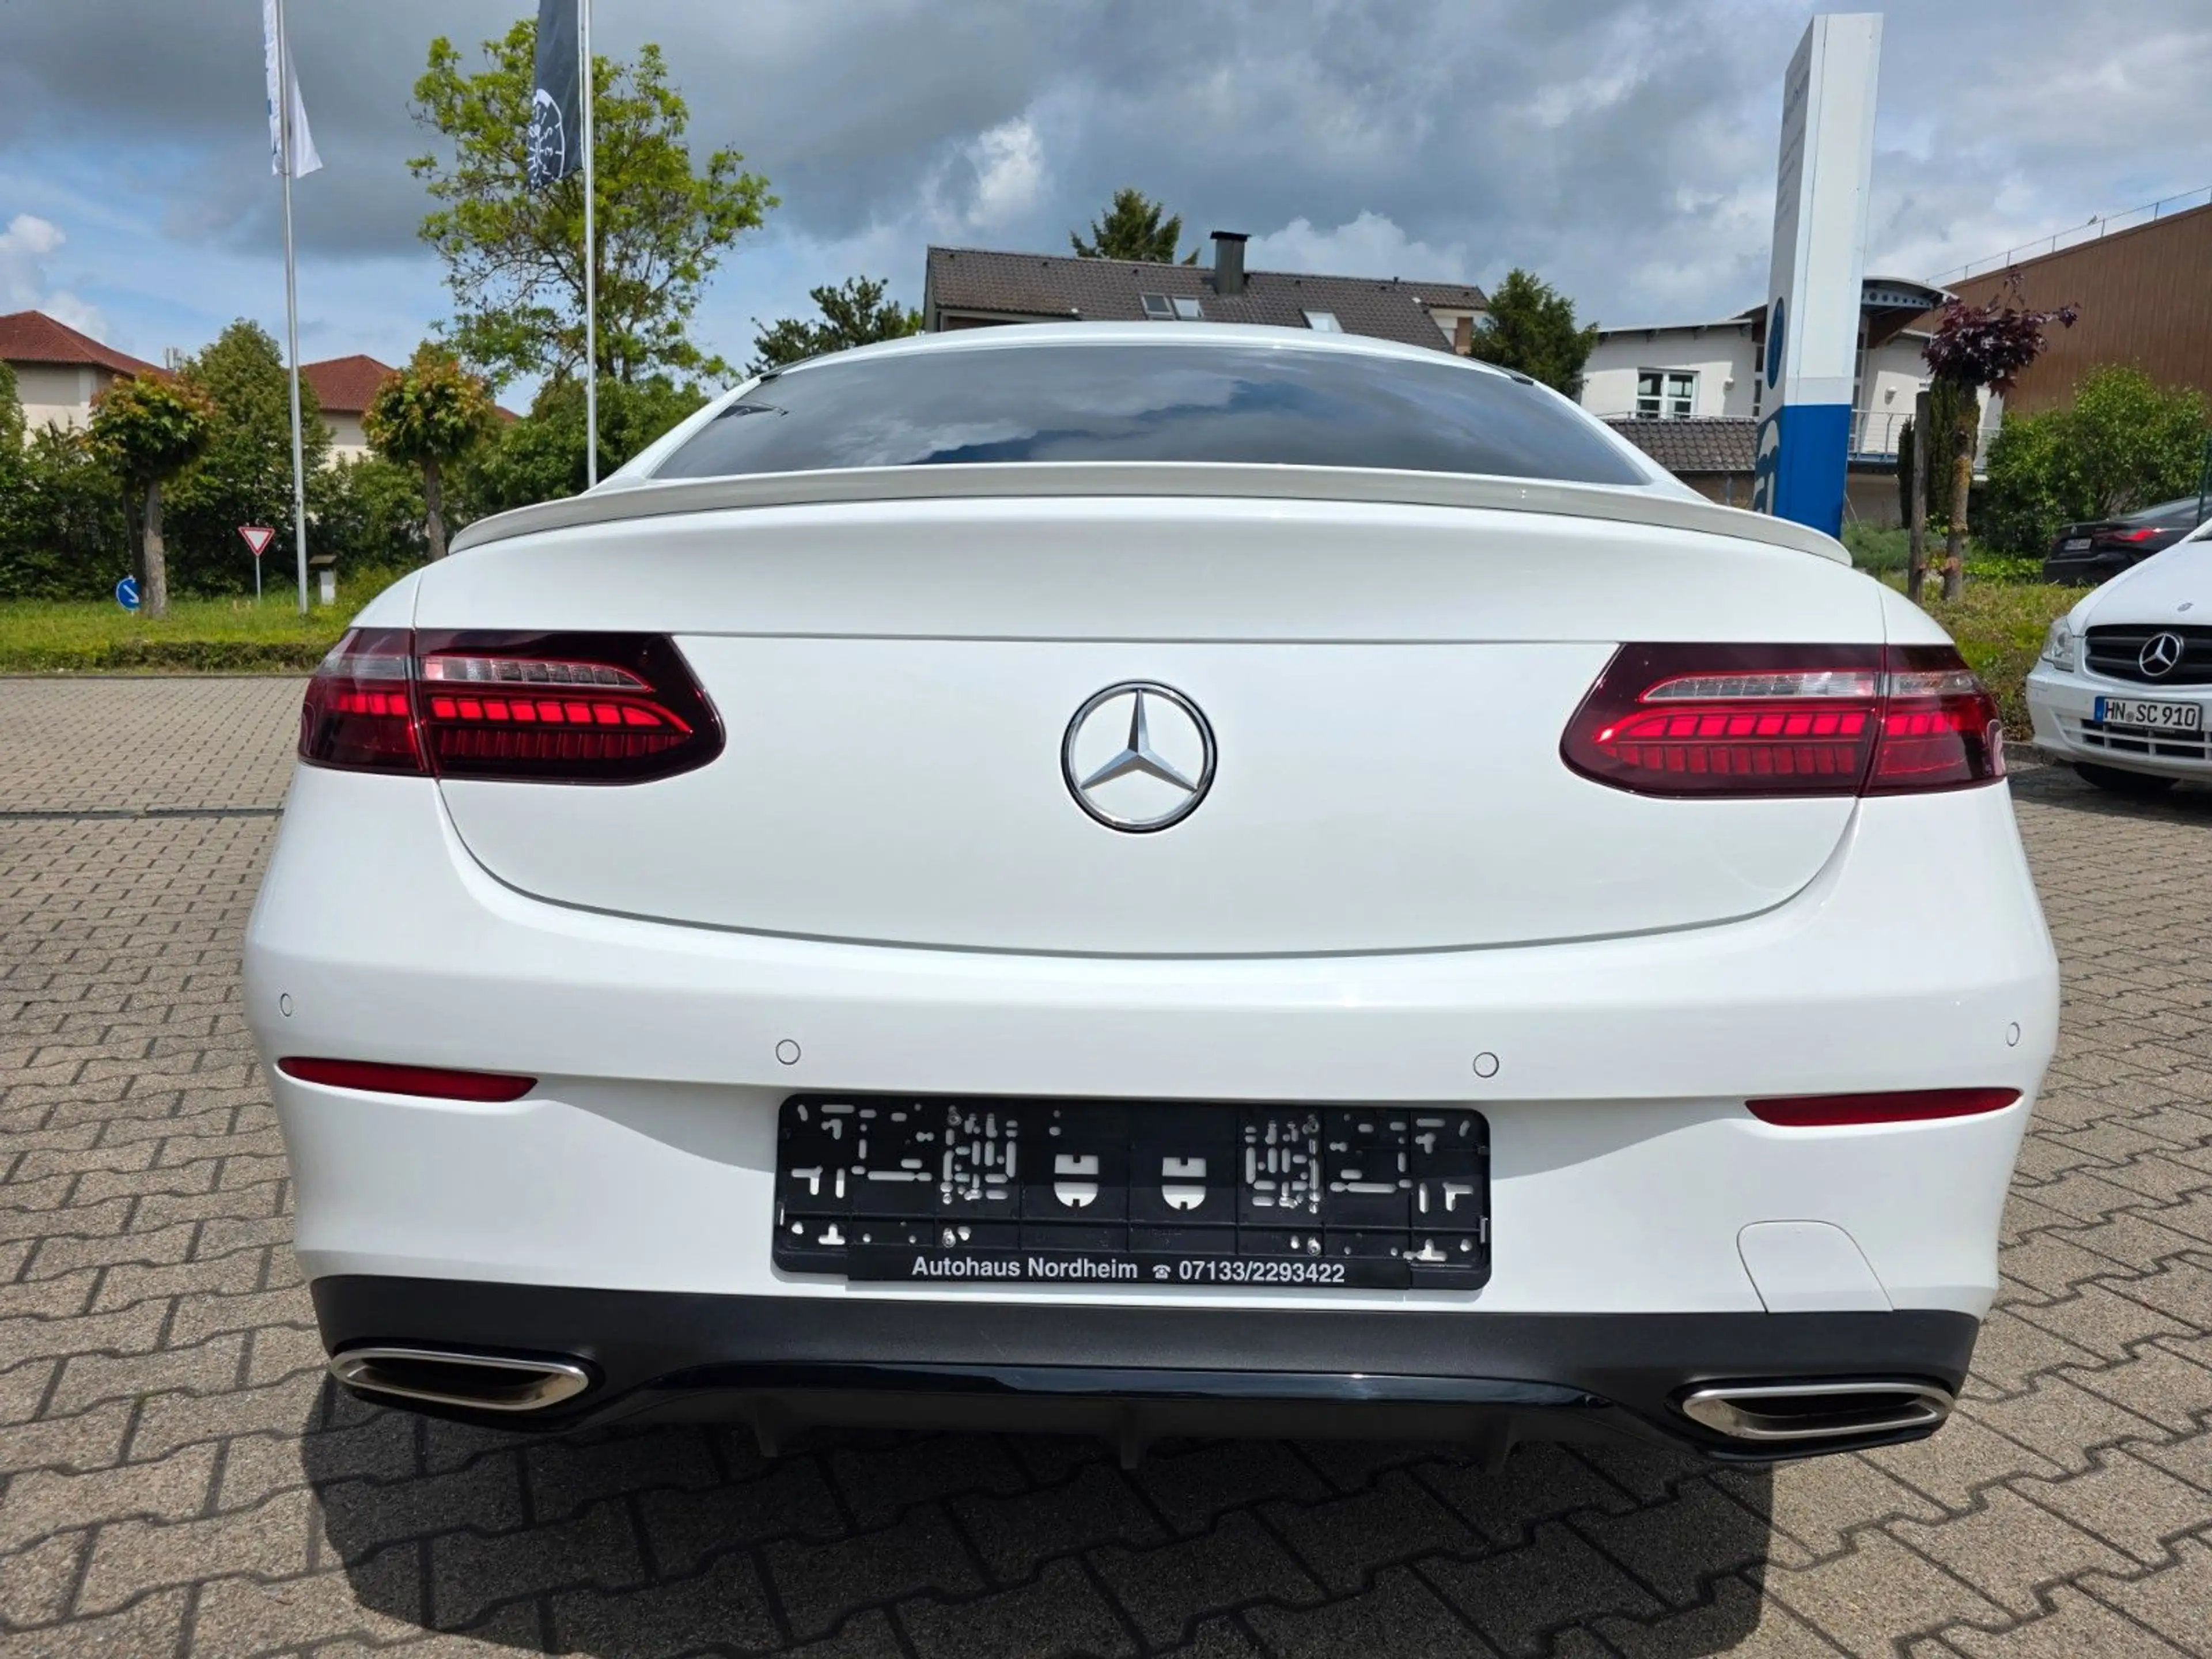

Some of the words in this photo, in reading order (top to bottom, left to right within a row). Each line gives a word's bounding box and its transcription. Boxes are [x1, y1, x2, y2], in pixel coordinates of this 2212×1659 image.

[2104, 701, 2126, 720] HN
[2135, 703, 2158, 723] SC
[2161, 706, 2196, 727] 910
[911, 1256, 1021, 1277] Autohaus
[1028, 1257, 1138, 1279] Nordheim
[1179, 1260, 1346, 1283] 07133/2293422
